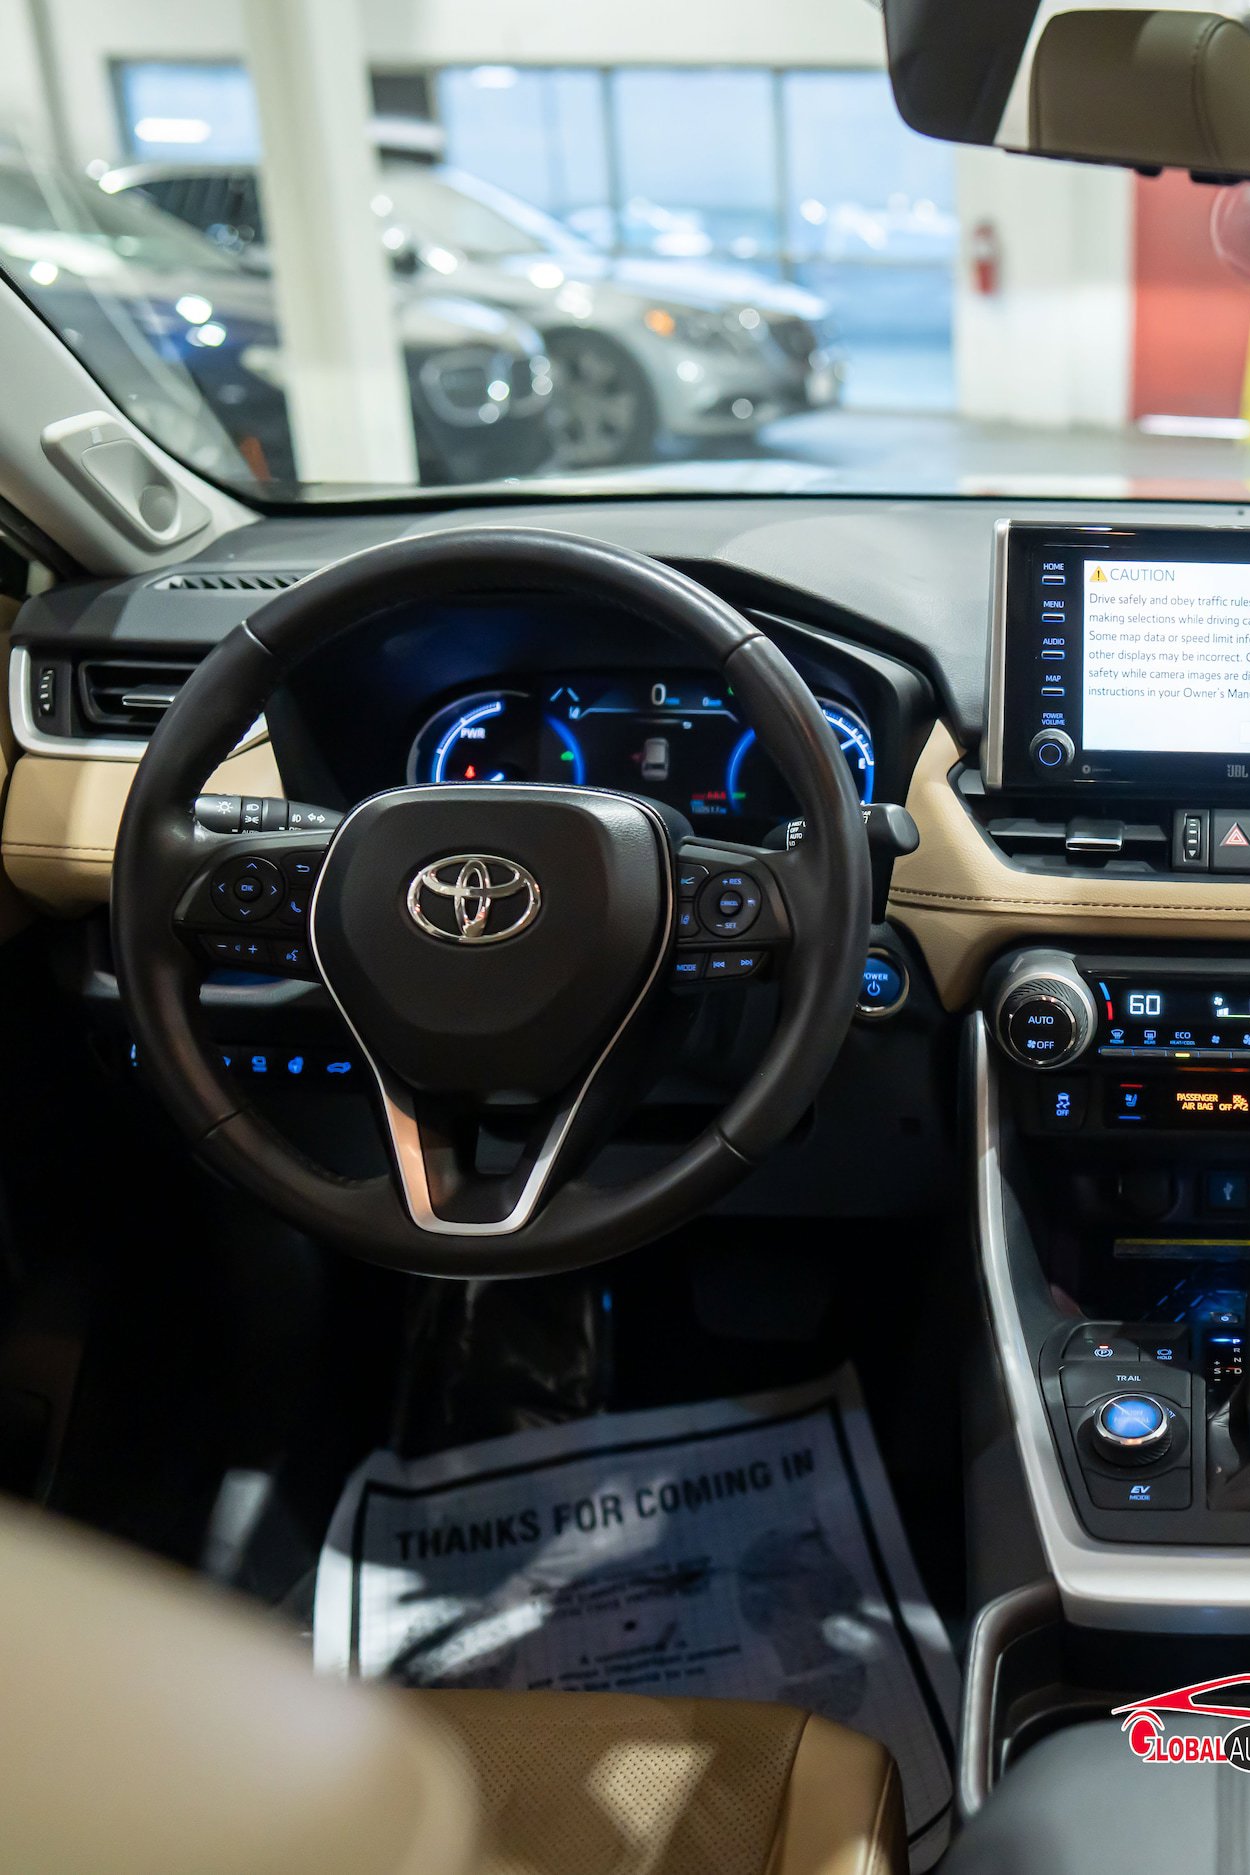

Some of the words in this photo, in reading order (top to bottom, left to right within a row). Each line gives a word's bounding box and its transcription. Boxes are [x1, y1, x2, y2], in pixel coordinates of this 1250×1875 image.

[1110, 568, 1175, 582] CAUTION
[1090, 593, 1116, 604] Drive
[1118, 594, 1146, 606] safely
[1150, 595, 1168, 605] and
[1170, 596, 1194, 607] obey
[1198, 596, 1228, 606] traffic
[1090, 614, 1124, 624] making
[1128, 614, 1176, 624] selections
[1178, 614, 1204, 624] while
[1207, 615, 1240, 627] driving
[1042, 638, 1065, 646] AUDIO
[1089, 630, 1117, 641] Some
[1120, 634, 1141, 644] map
[1144, 632, 1166, 642] data
[1168, 634, 1178, 642] or
[1182, 634, 1210, 644] speed
[1213, 634, 1233, 644] limit
[1088, 650, 1114, 660] other
[1118, 650, 1156, 662] displays
[1159, 652, 1180, 662] may
[1182, 652, 1194, 662] be
[1196, 652, 1242, 662] incorrect.
[1088, 668, 1118, 680] safety
[1122, 668, 1147, 678] while
[1150, 671, 1184, 680] camera
[1188, 671, 1221, 682] images
[1224, 672, 1239, 681] are
[652, 683, 666, 706] 0
[1088, 686, 1144, 696] instructions
[1148, 688, 1156, 697] in
[1158, 689, 1180, 698] your
[1184, 688, 1224, 698] Owner's
[460, 728, 486, 738] PWR
[1129, 994, 1160, 1015] 60
[1028, 1016, 1054, 1024] AUTO
[1036, 1041, 1054, 1050] OFF
[1176, 1093, 1218, 1102] PASSENGER
[1182, 1102, 1196, 1110] AIR
[1197, 1102, 1214, 1110] BAG
[396, 1510, 542, 1563] THANKS
[553, 1494, 626, 1537] FOR
[635, 1460, 774, 1520] COMING
[782, 1448, 816, 1480] IN
